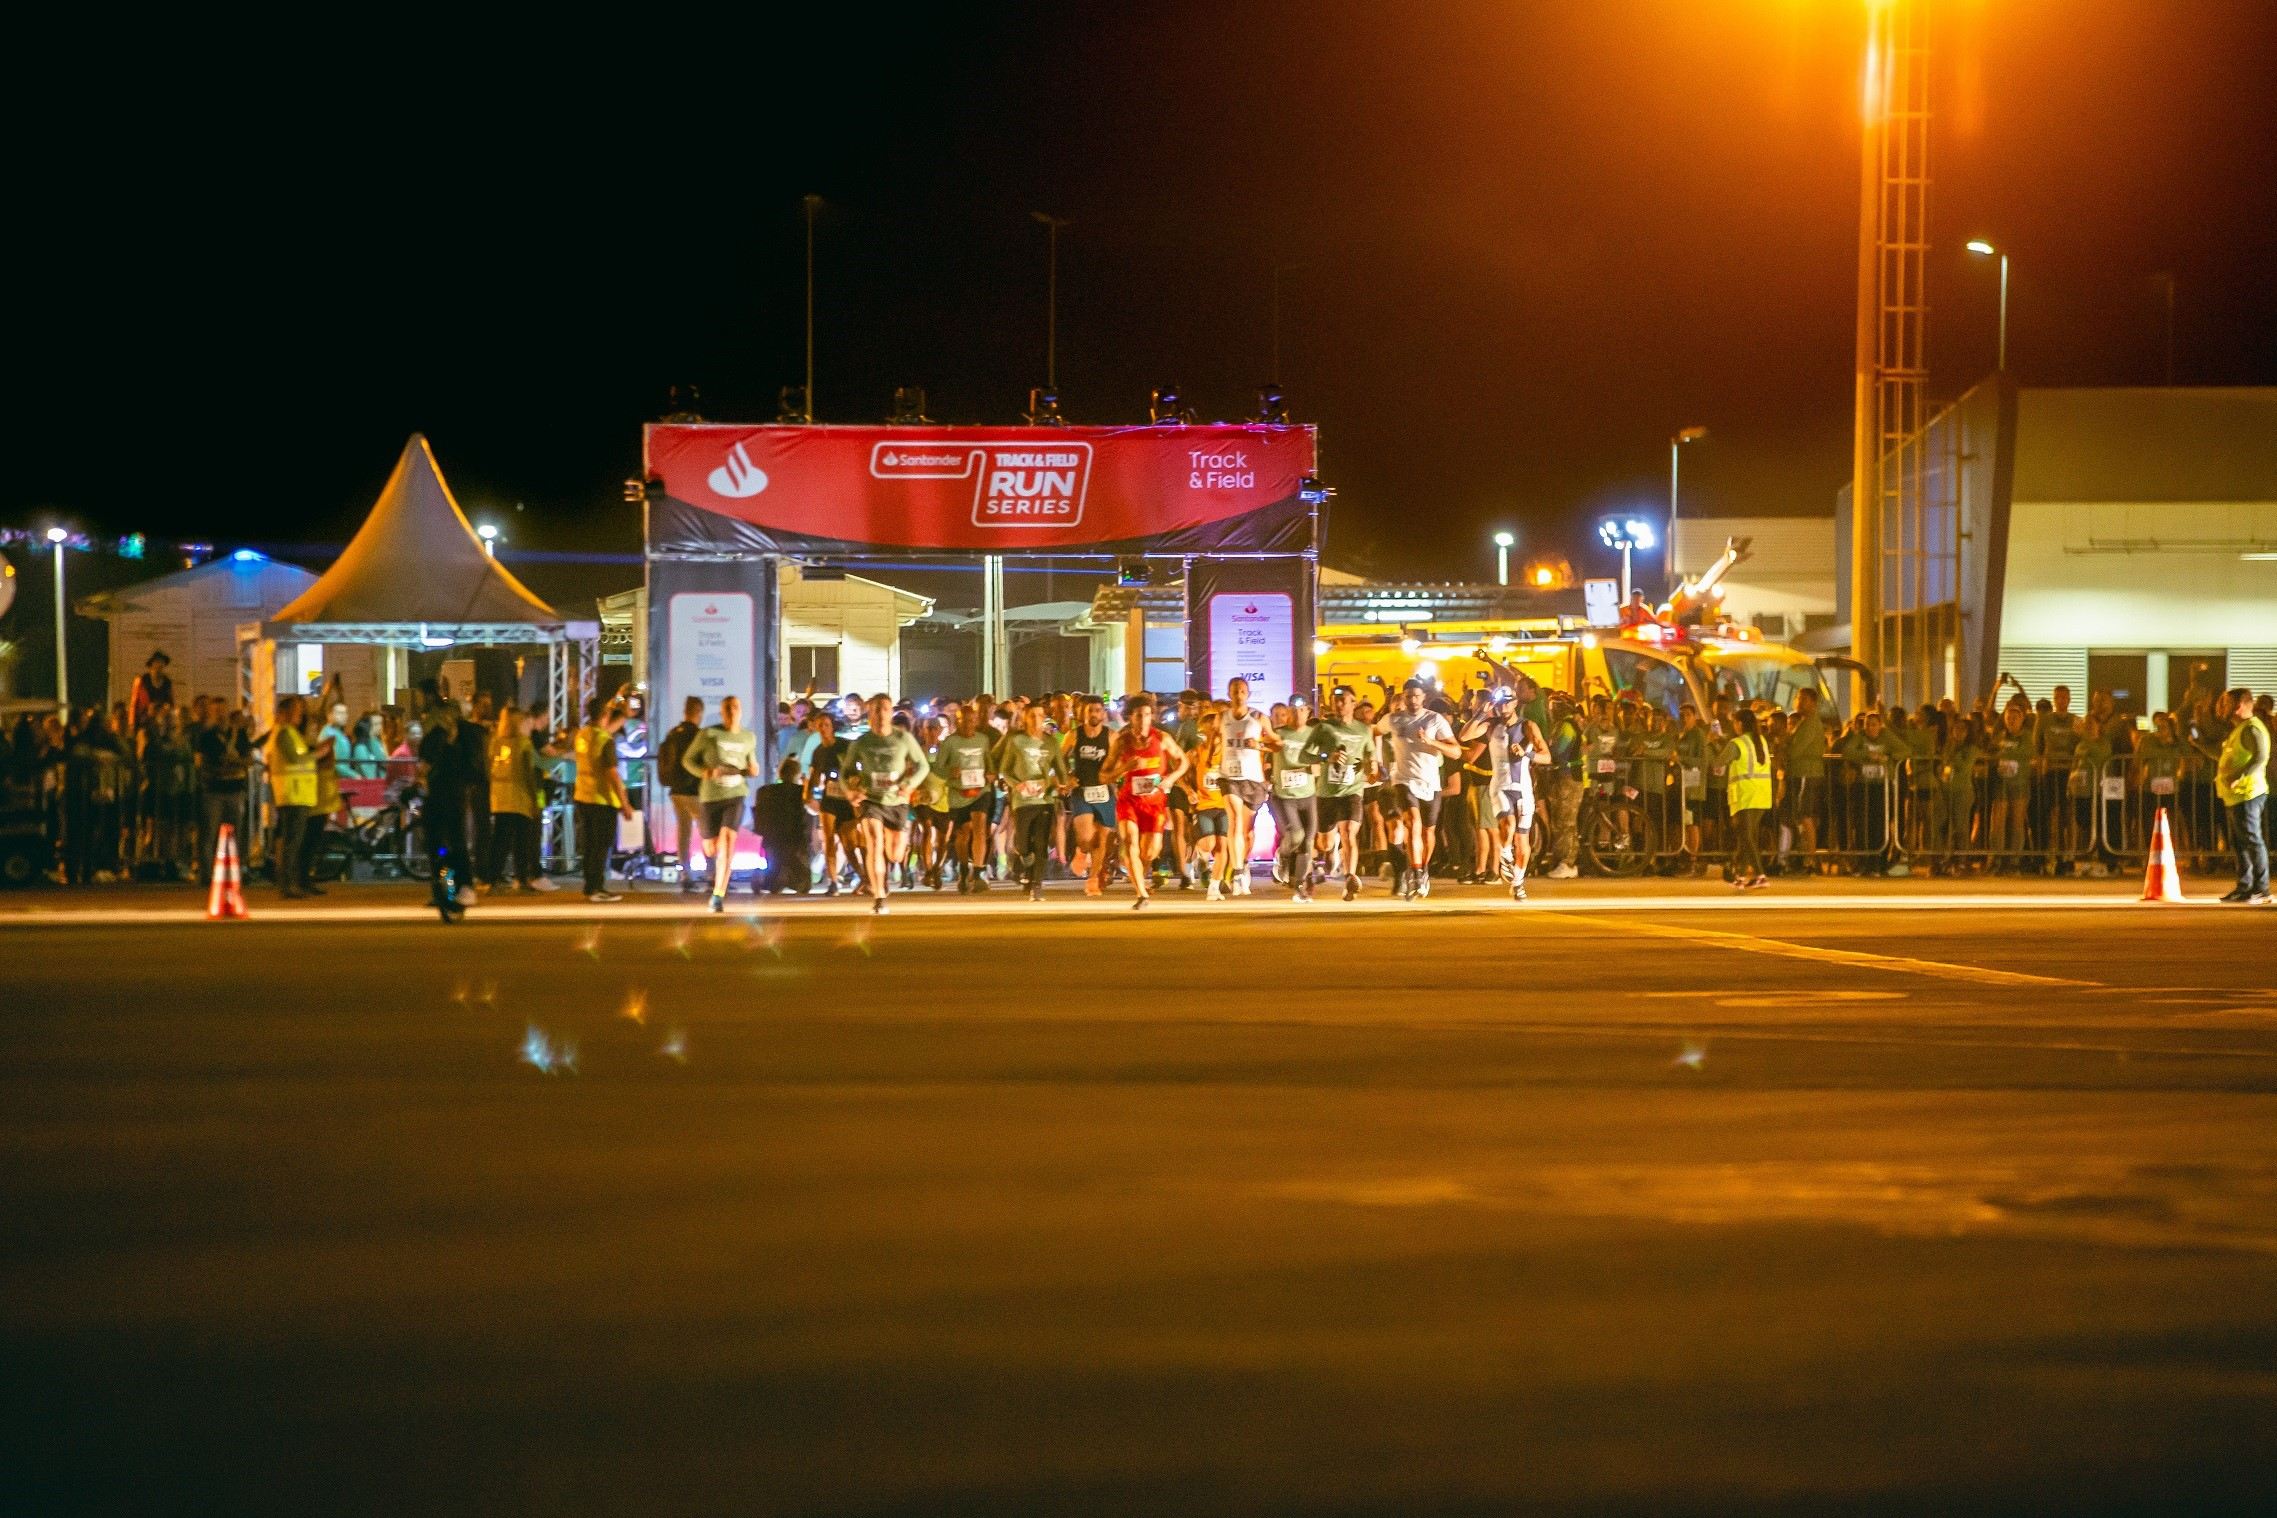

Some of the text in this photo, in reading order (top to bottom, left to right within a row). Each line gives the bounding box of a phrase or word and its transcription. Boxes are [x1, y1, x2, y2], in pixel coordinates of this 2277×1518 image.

[899, 454, 962, 466] Santander
[1188, 451, 1248, 468] Track
[988, 471, 1077, 497] RUN
[1189, 472, 1254, 488] & Field
[986, 499, 1071, 514] SERIES
